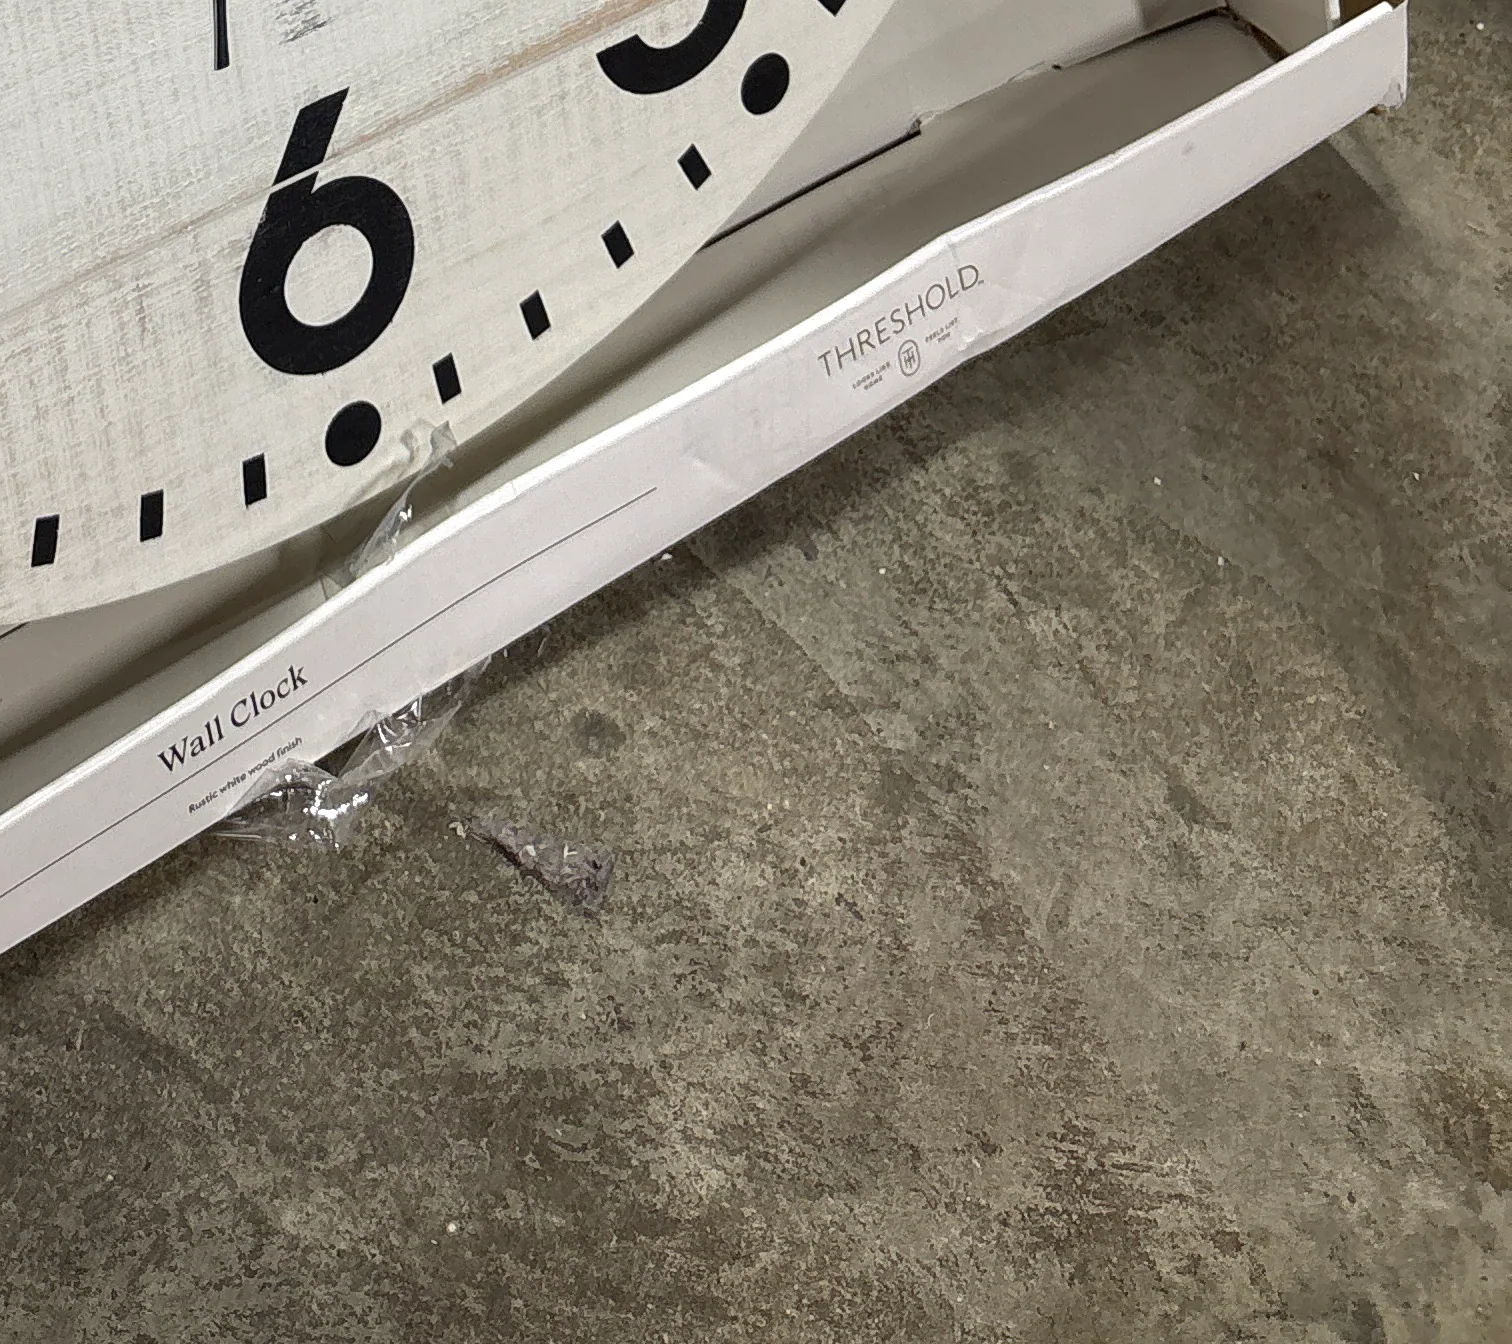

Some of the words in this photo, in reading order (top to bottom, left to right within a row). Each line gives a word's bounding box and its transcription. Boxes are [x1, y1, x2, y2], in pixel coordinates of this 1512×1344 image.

[239, 88, 414, 375] 6
[157, 714, 225, 772] Wall
[230, 665, 308, 728] Clock
[188, 791, 218, 813] Rustic
[219, 773, 246, 793] white
[248, 753, 275, 775] wood
[277, 737, 302, 758] finish
